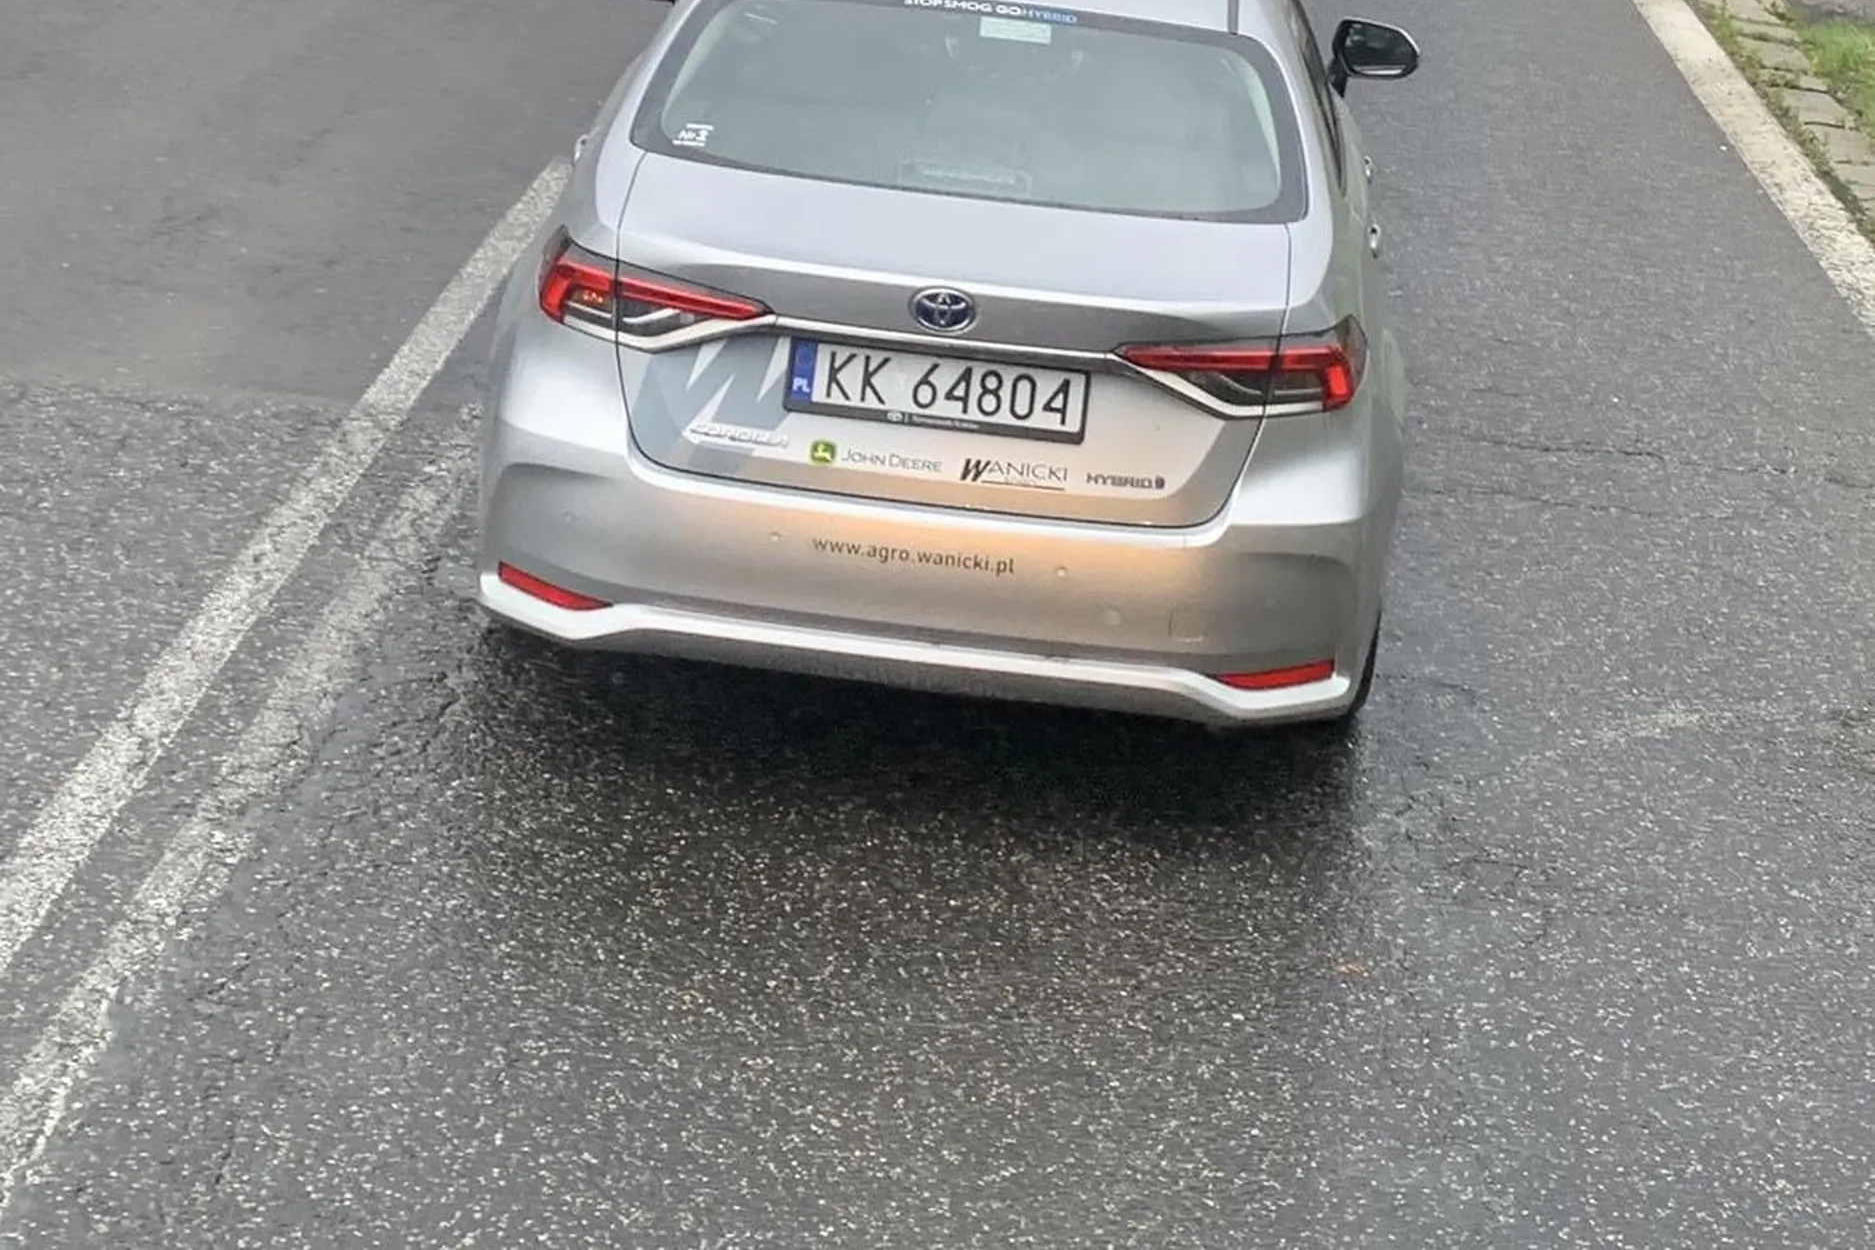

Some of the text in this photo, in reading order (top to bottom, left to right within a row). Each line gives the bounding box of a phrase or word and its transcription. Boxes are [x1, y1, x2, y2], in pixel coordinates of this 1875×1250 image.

[792, 377, 811, 393] PL
[826, 351, 1071, 426] KK 64804
[842, 447, 944, 473] JOHN DEERE
[959, 458, 1068, 482] WANICKI
[1086, 472, 1153, 490] HYBRID
[812, 537, 1015, 577] www.agro.wanicki.pl
